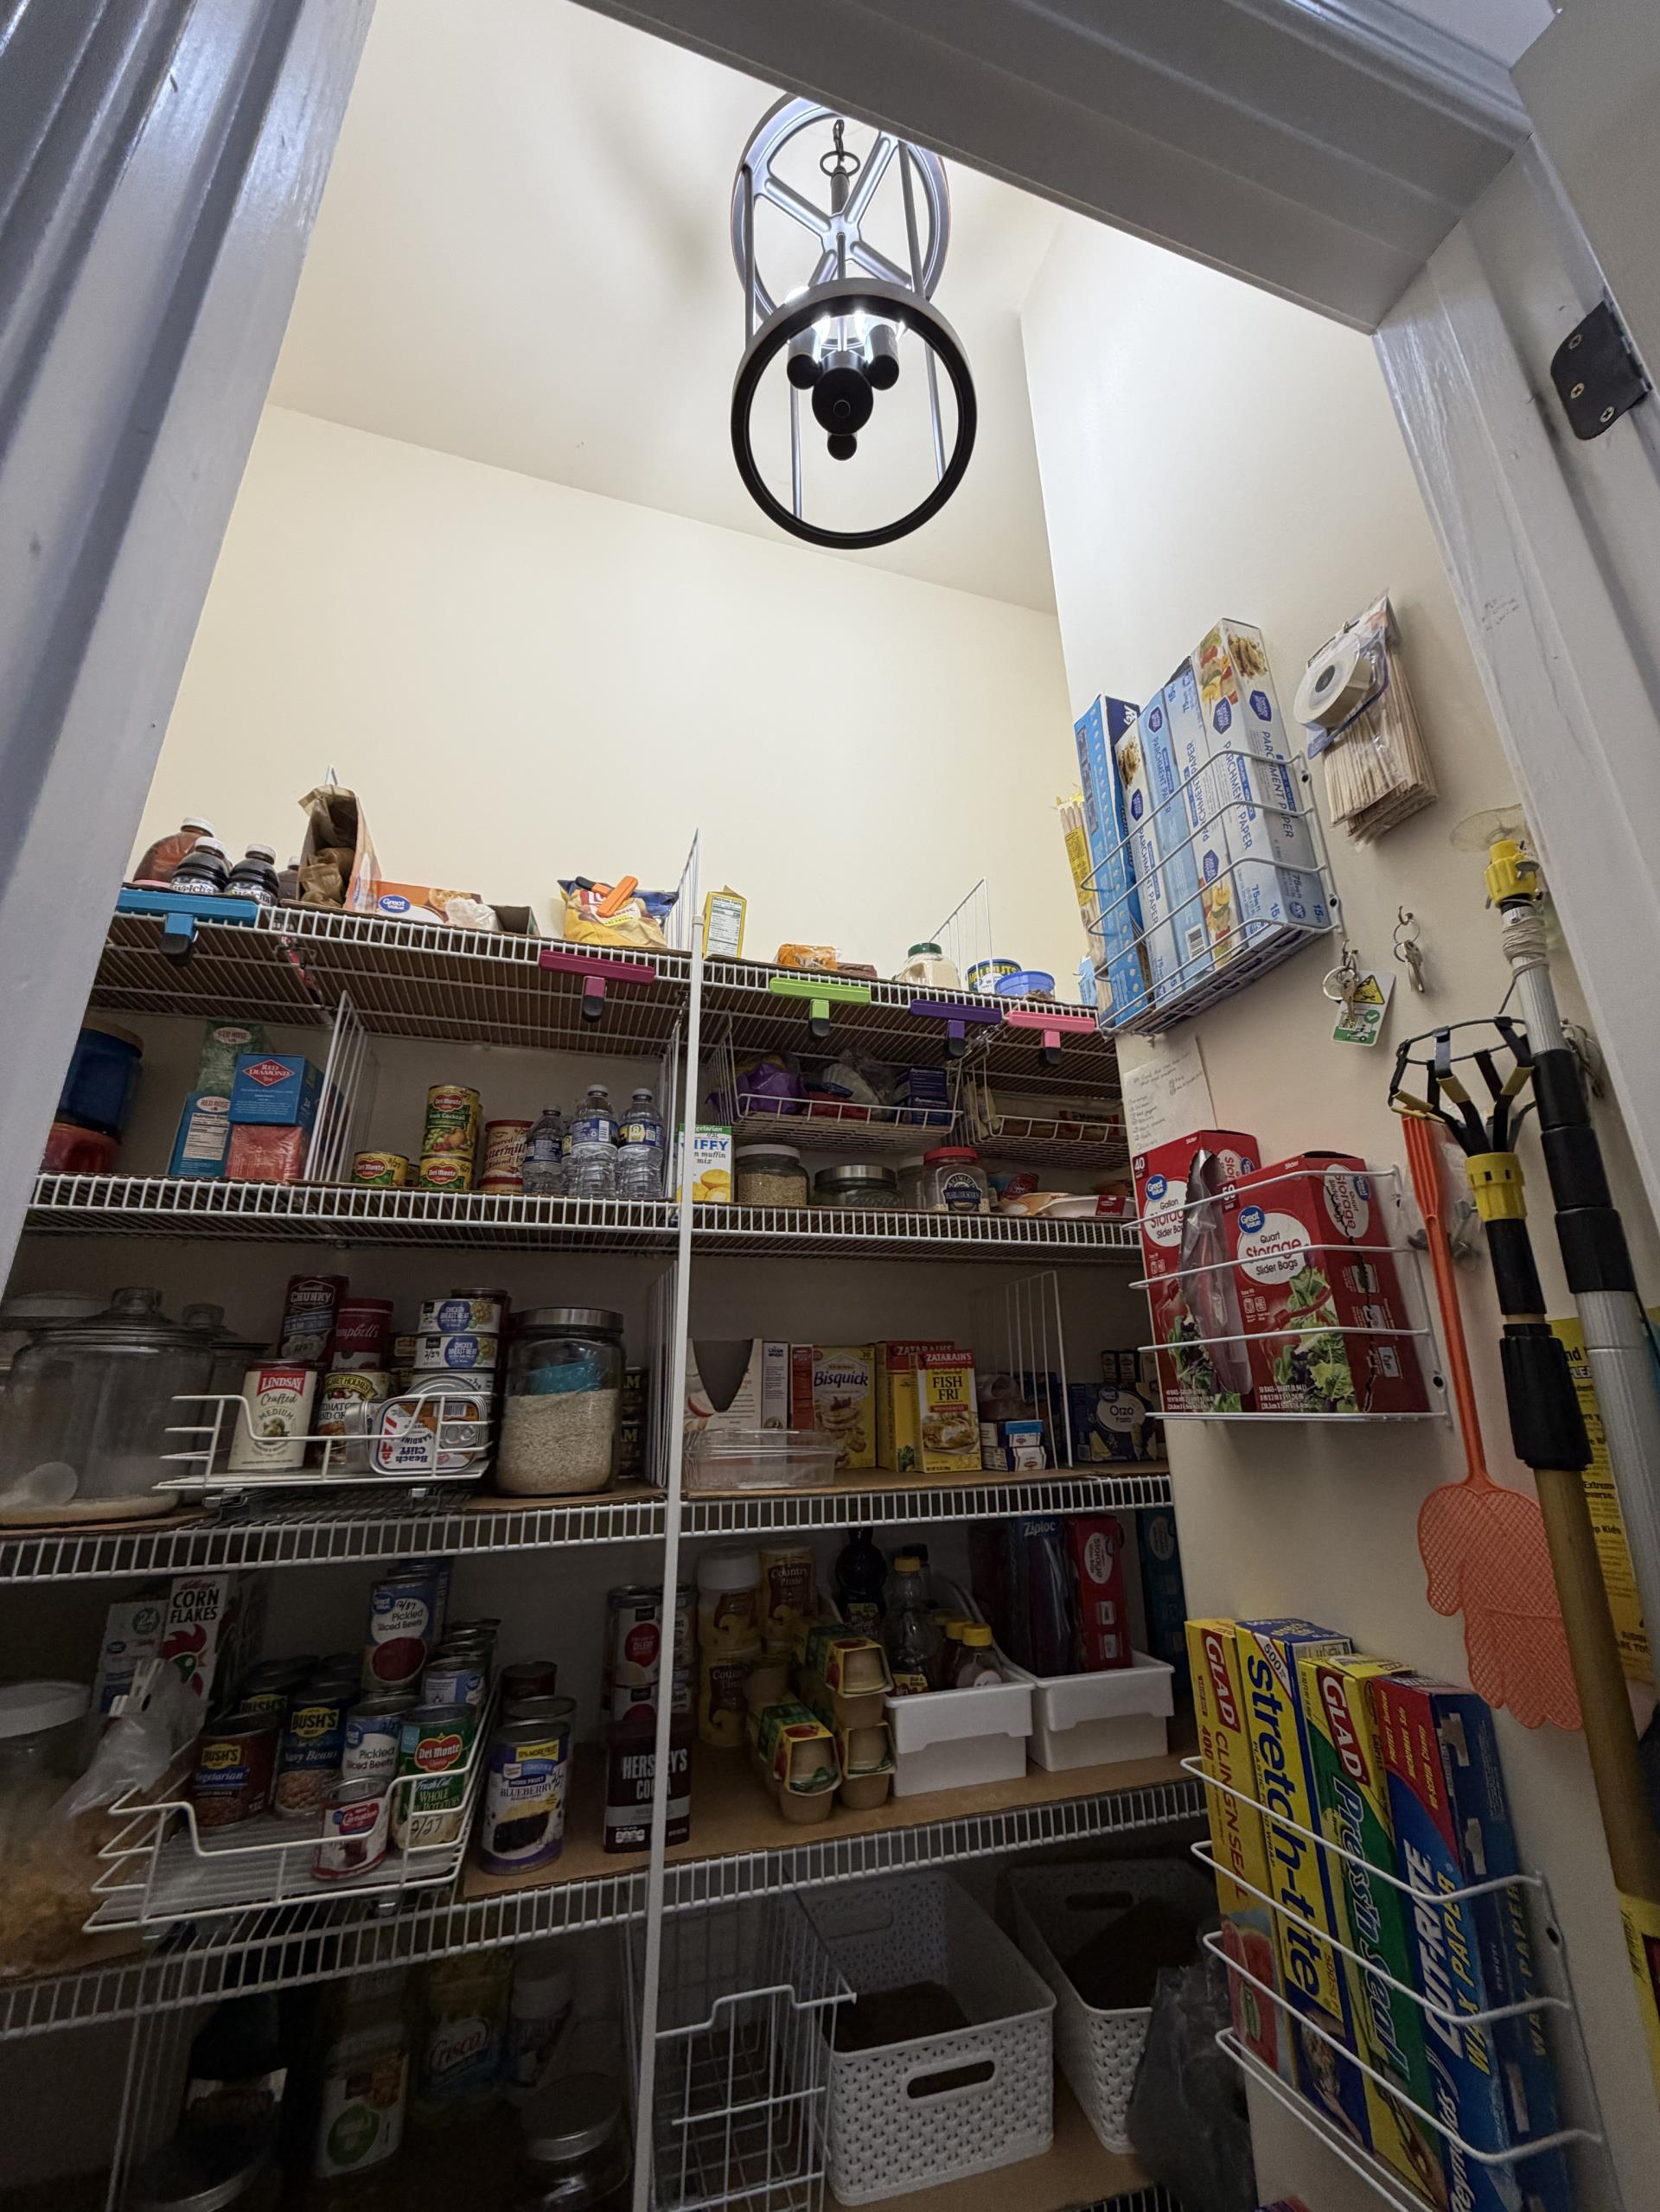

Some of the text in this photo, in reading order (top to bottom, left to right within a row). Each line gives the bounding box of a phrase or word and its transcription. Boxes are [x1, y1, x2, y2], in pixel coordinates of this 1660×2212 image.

[1152, 736, 1168, 788] PARCHMENT
[1278, 801, 1294, 838] PPER
[1237, 813, 1253, 850] PAPER
[383, 898, 405, 907] Great
[1148, 892, 1159, 927] PAPER
[200, 1098, 214, 1107] RED
[693, 1139, 729, 1151] IFFY
[701, 1151, 726, 1159] muffin
[1134, 1157, 1146, 1169] 40
[1147, 1179, 1164, 1190] Great
[1159, 1199, 1179, 1210] Gallon
[1150, 1209, 1184, 1228] Storag
[1240, 1211, 1260, 1225] Great
[1246, 1220, 1261, 1228] Value
[1156, 1229, 1172, 1240] Slider
[1260, 1231, 1280, 1244] Quart
[1246, 1237, 1301, 1262] Storage
[1255, 1258, 1298, 1277] Slider Bags
[290, 1291, 332, 1303] CHUNKY
[335, 1323, 380, 1338] ampbell's
[926, 1353, 973, 1362] ZATARAIN'S
[814, 1370, 868, 1388] Bisquick
[933, 1376, 963, 1388] FISH
[260, 1393, 297, 1406] Crafted
[938, 1388, 960, 1400] FRI
[259, 1407, 294, 1420] MEDIUM
[1109, 1405, 1134, 1417] Orzo
[399, 1446, 426, 1456] Cliff
[395, 1455, 428, 1463] Beach
[1024, 1520, 1056, 1538] Ziploc
[770, 1567, 808, 1578] Country
[172, 1589, 220, 1609] CORN
[169, 1606, 218, 1624] FLAKES
[392, 1610, 423, 1622] Pickled
[1263, 1642, 1281, 1671] 500
[1205, 1635, 1236, 1726] GLAD
[293, 1712, 337, 1731] BUSH'S
[1322, 1673, 1363, 1777] GLAD
[203, 1747, 239, 1764] BUSH'S
[306, 1750, 338, 1761] Beans
[359, 1746, 396, 1759] Pickled
[418, 1744, 459, 1760] Del Monte
[622, 1747, 688, 1780] HERSY'S
[1253, 1739, 1265, 1797] PLASTIC
[419, 1788, 450, 1802] WHOLE
[500, 1785, 552, 1797] BLUEBERRY
[1248, 1654, 1322, 1996] Stretch-tte
[1333, 1775, 1411, 2081] Press'n Seal
[1436, 1871, 1475, 1988] PAPER
